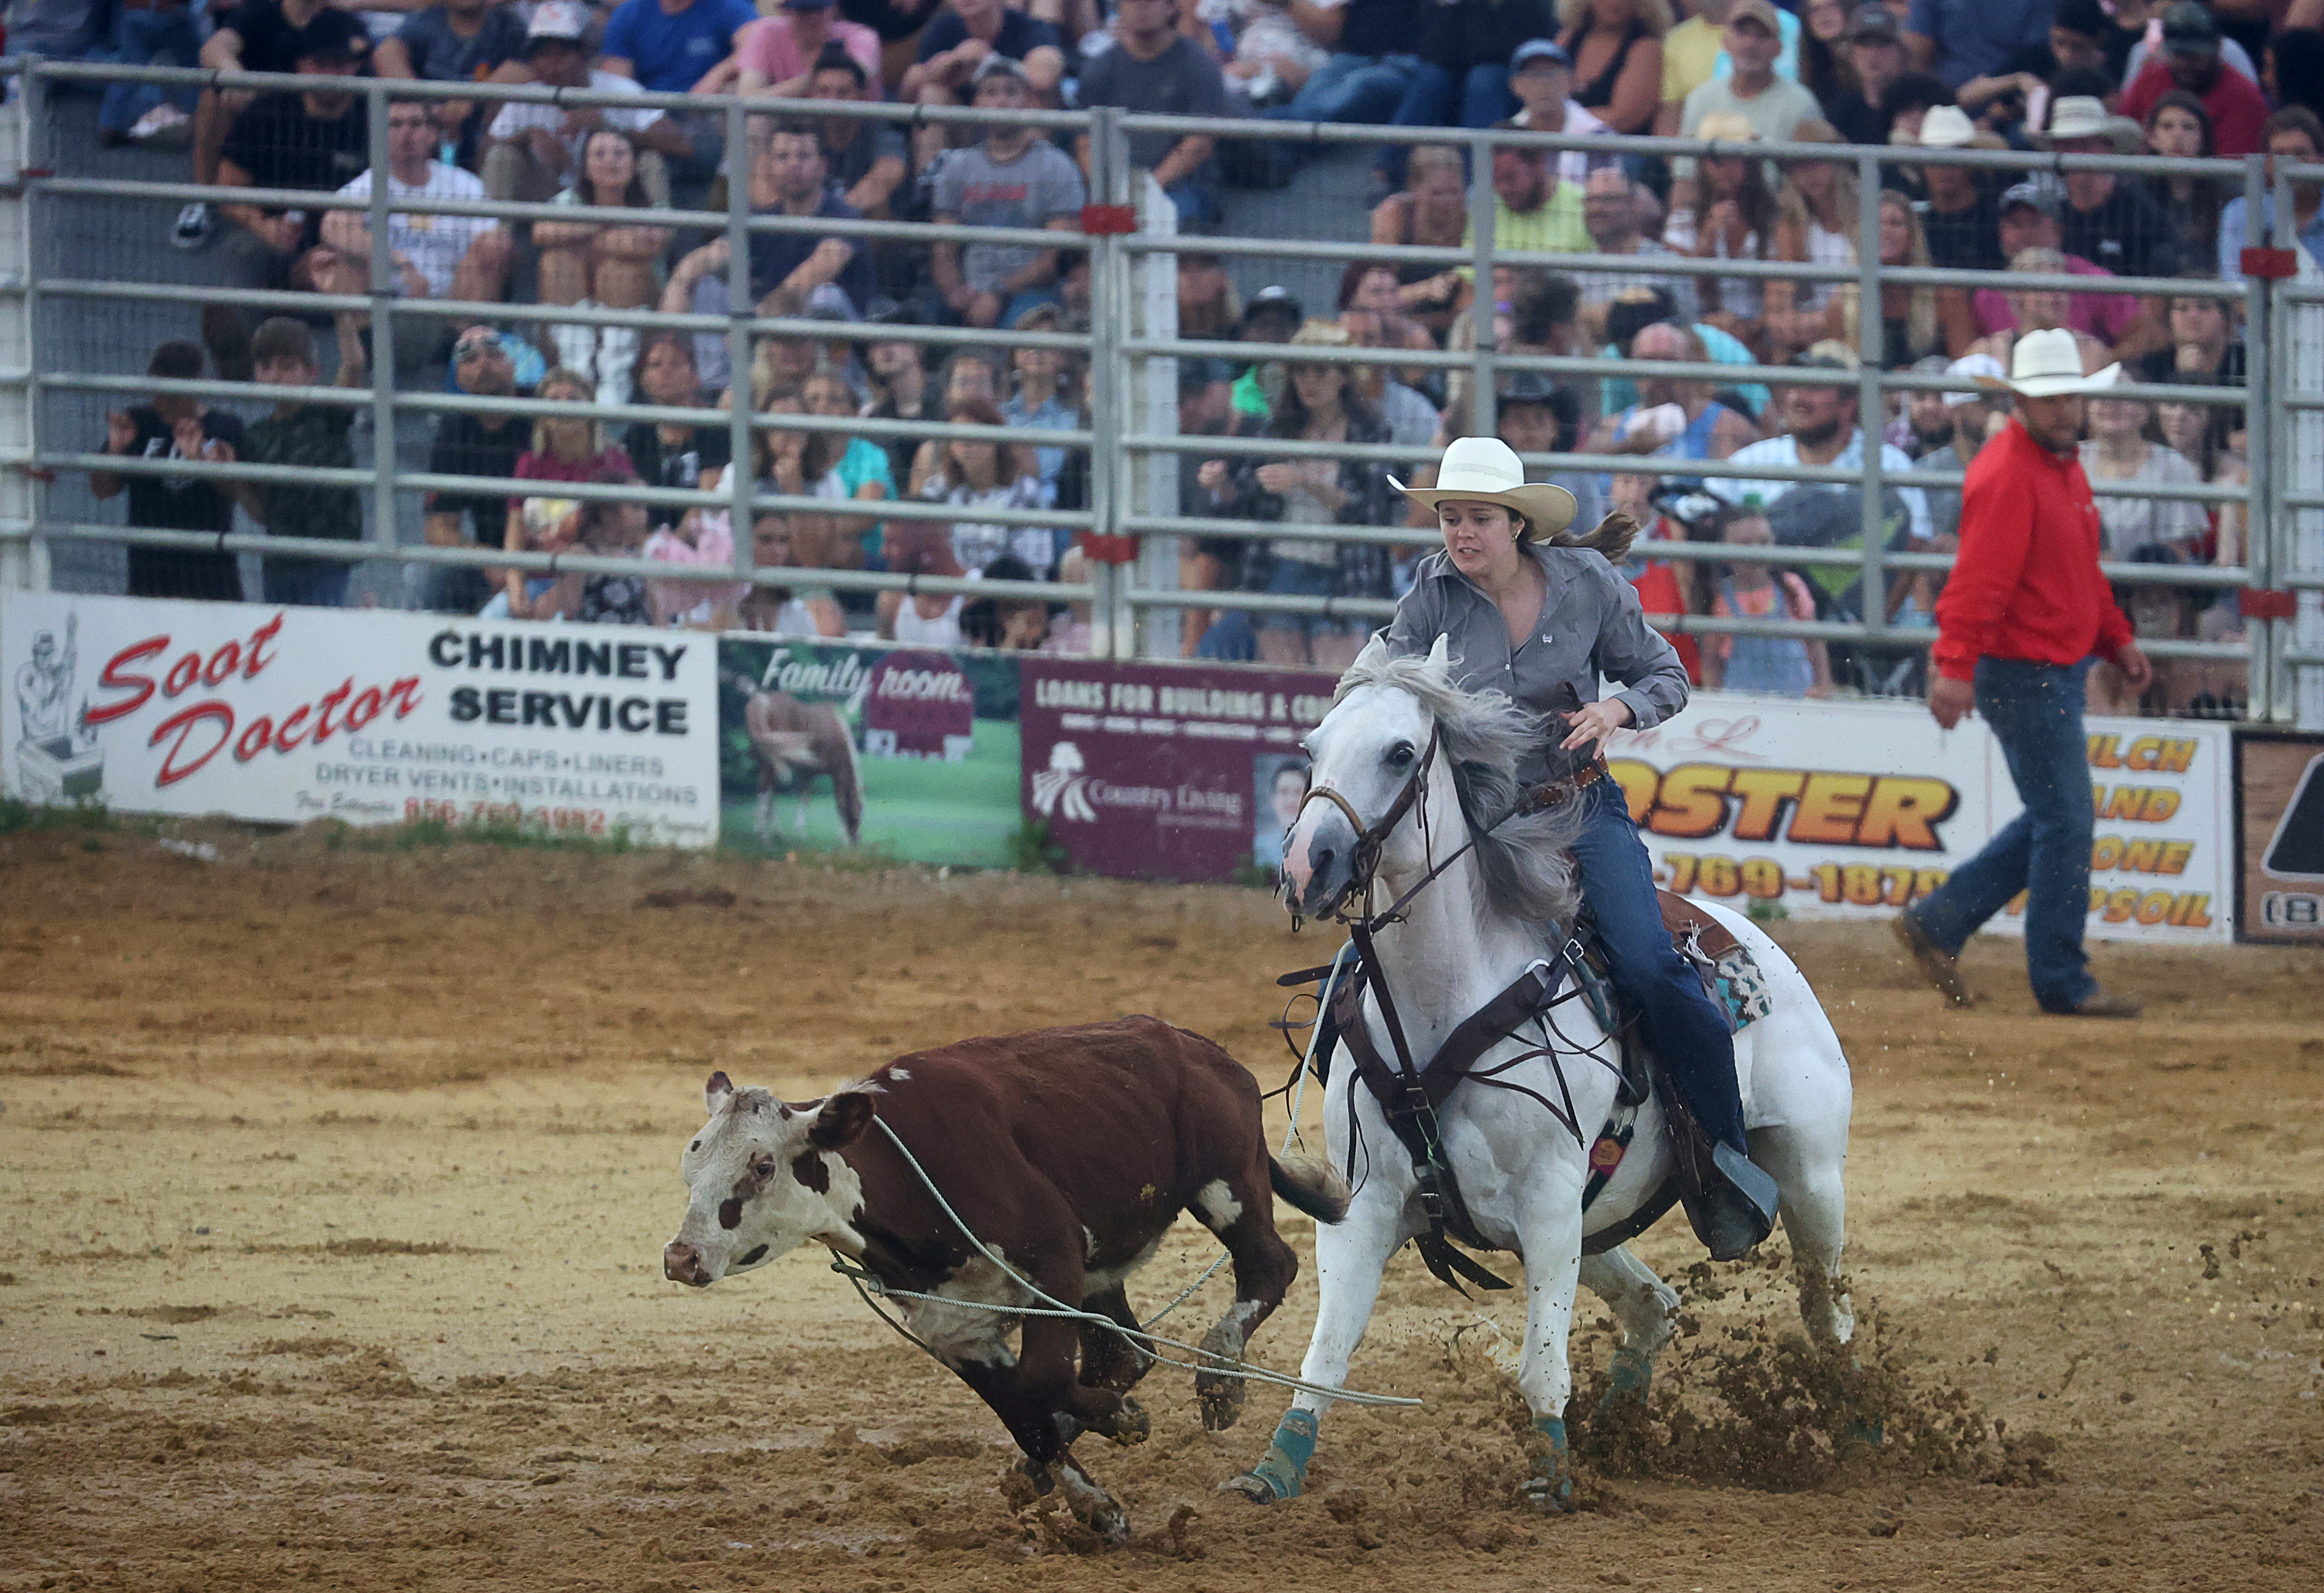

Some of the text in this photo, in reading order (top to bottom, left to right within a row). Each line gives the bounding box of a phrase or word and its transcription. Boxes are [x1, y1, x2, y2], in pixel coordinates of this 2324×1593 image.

[83, 611, 284, 725] Soot
[429, 630, 687, 680] CHIMNEY
[761, 648, 873, 714] Family
[1035, 678, 1105, 708] LOANS
[1110, 682, 1154, 712] FOR
[1159, 686, 1264, 721] BUILDING
[150, 674, 424, 787] Doctor
[449, 685, 688, 735] SERVICE
[349, 738, 664, 776] CLEANING CAPS LINERS
[316, 762, 698, 804] DRYER VENTS INSTALLATIONS
[1606, 757, 1960, 851] OSTER
[2091, 835, 2195, 875] ONE
